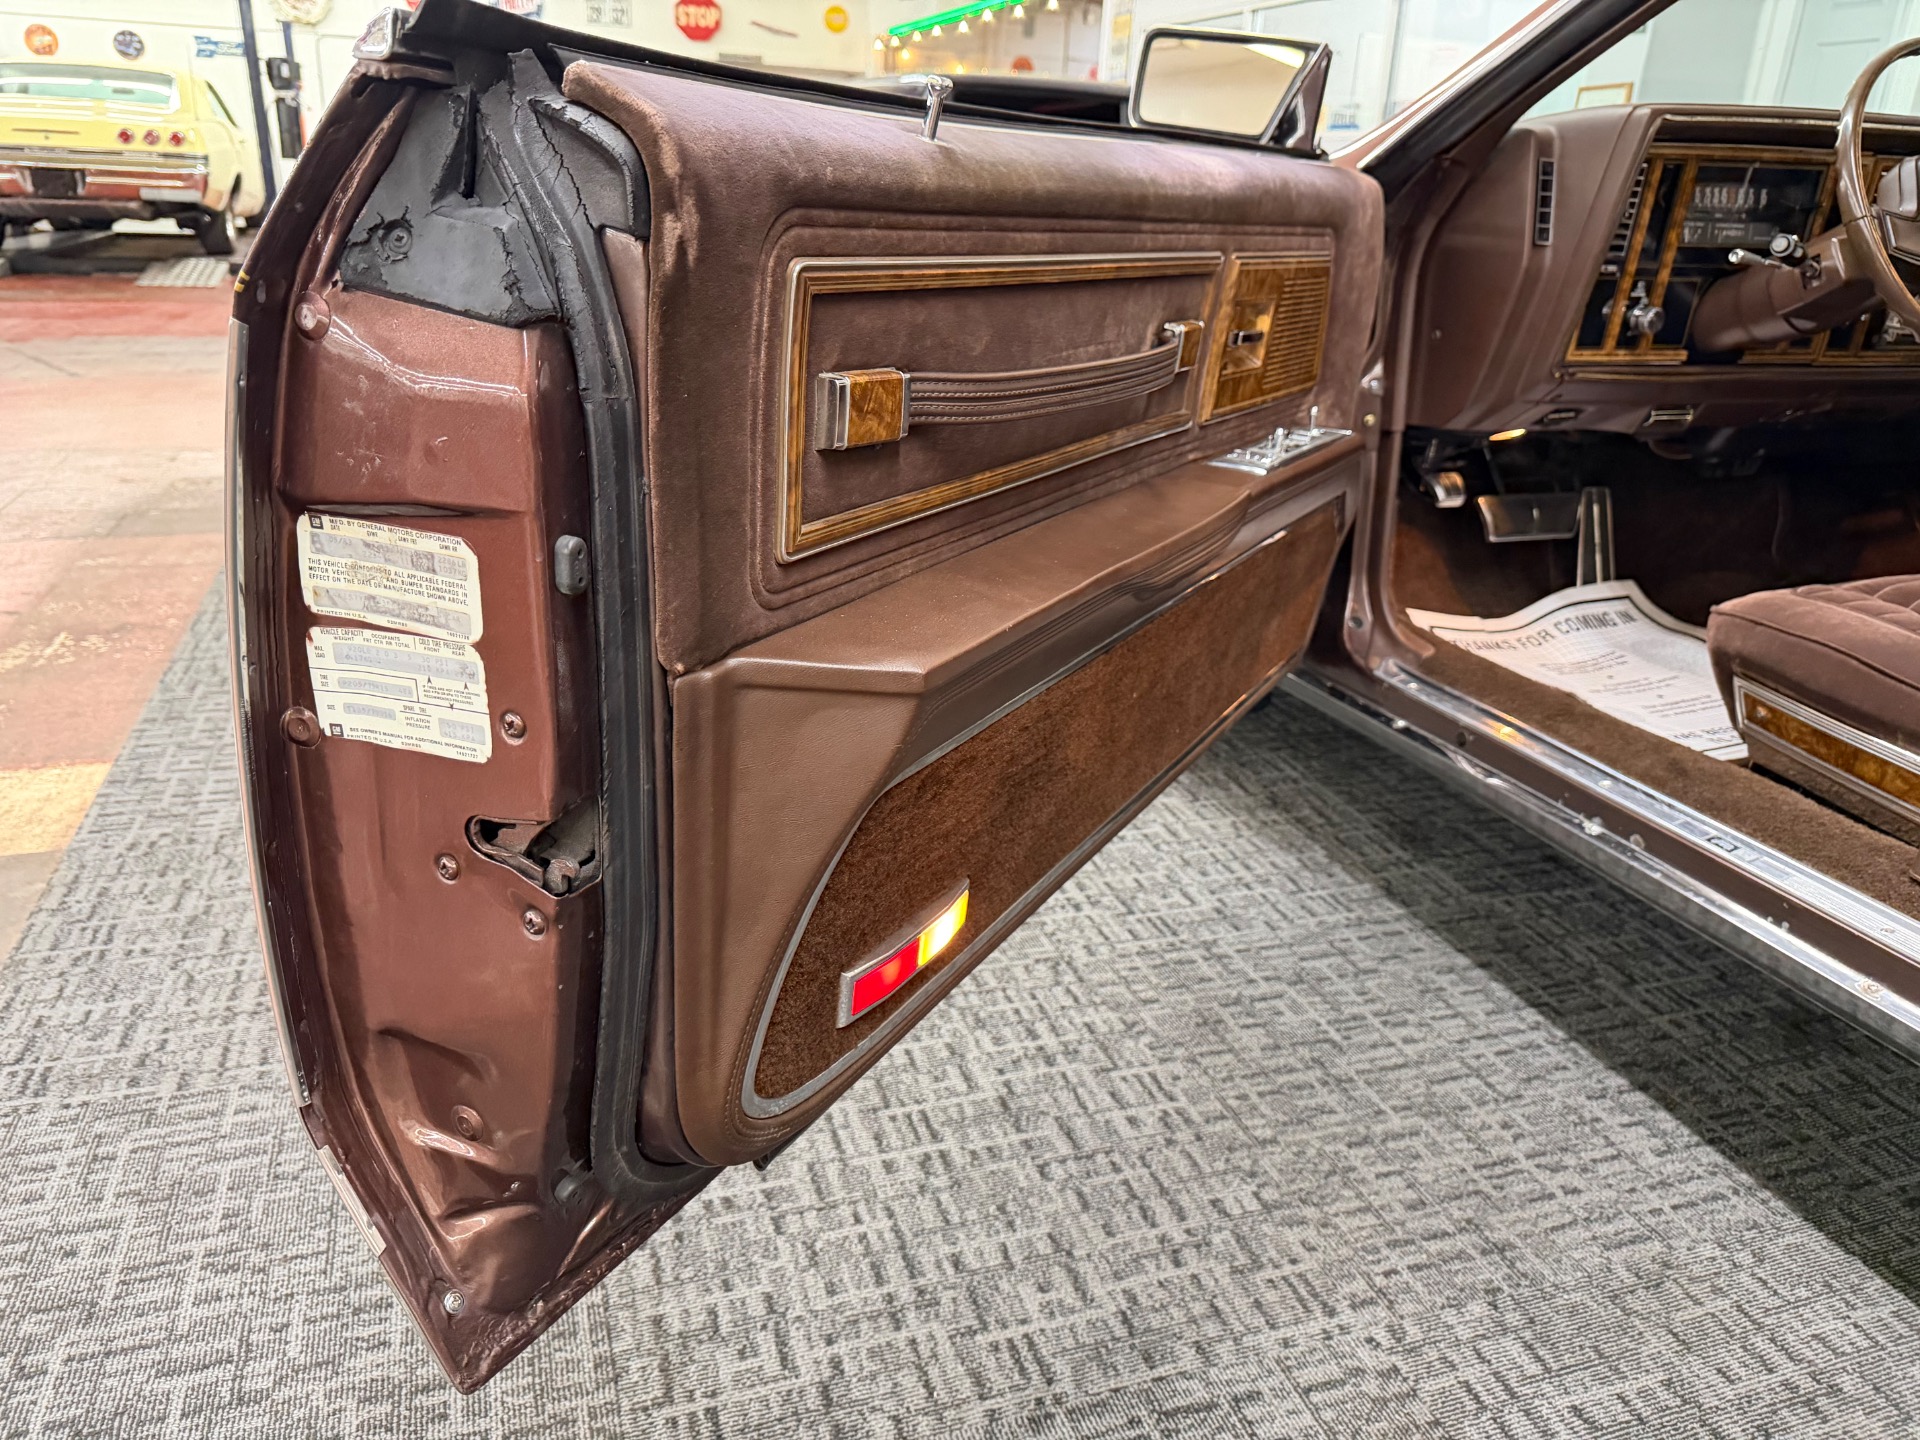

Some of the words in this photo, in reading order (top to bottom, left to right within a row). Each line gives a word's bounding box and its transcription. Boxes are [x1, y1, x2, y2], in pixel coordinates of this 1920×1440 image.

[677, 4, 720, 28] STOP
[356, 522, 386, 532] GENERAL
[388, 526, 414, 538] MOTORS
[414, 532, 462, 546] CORPORATION
[308, 558, 322, 566] THIS
[322, 560, 348, 569] VEHICLE
[394, 570, 406, 579] ALL
[406, 573, 440, 586] APPLICABLE
[441, 580, 468, 591] FEDERAL
[308, 566, 329, 574] MOTOR
[401, 580, 422, 589] BUMPER
[426, 584, 460, 597] STANDARDS
[309, 573, 330, 582] EFFECT
[384, 584, 426, 597] MANUFACTURE
[426, 592, 446, 602] SHOWN
[320, 628, 339, 636] VEHICLE
[340, 628, 364, 638] CAPACITY
[370, 632, 401, 642] OCCUPANTS
[1517, 629, 1555, 650] FOR
[1553, 612, 1618, 635] COMING
[1618, 609, 1638, 625] IN
[418, 638, 430, 646] COLD
[431, 640, 442, 648] TIRE
[442, 642, 466, 652] PRESSURE
[404, 716, 430, 724] INFLATION
[360, 728, 382, 736] OWNER'S
[382, 732, 404, 740] MANUAL
[414, 736, 444, 747] ADDITIONAL
[444, 742, 478, 752] INFORMATION
